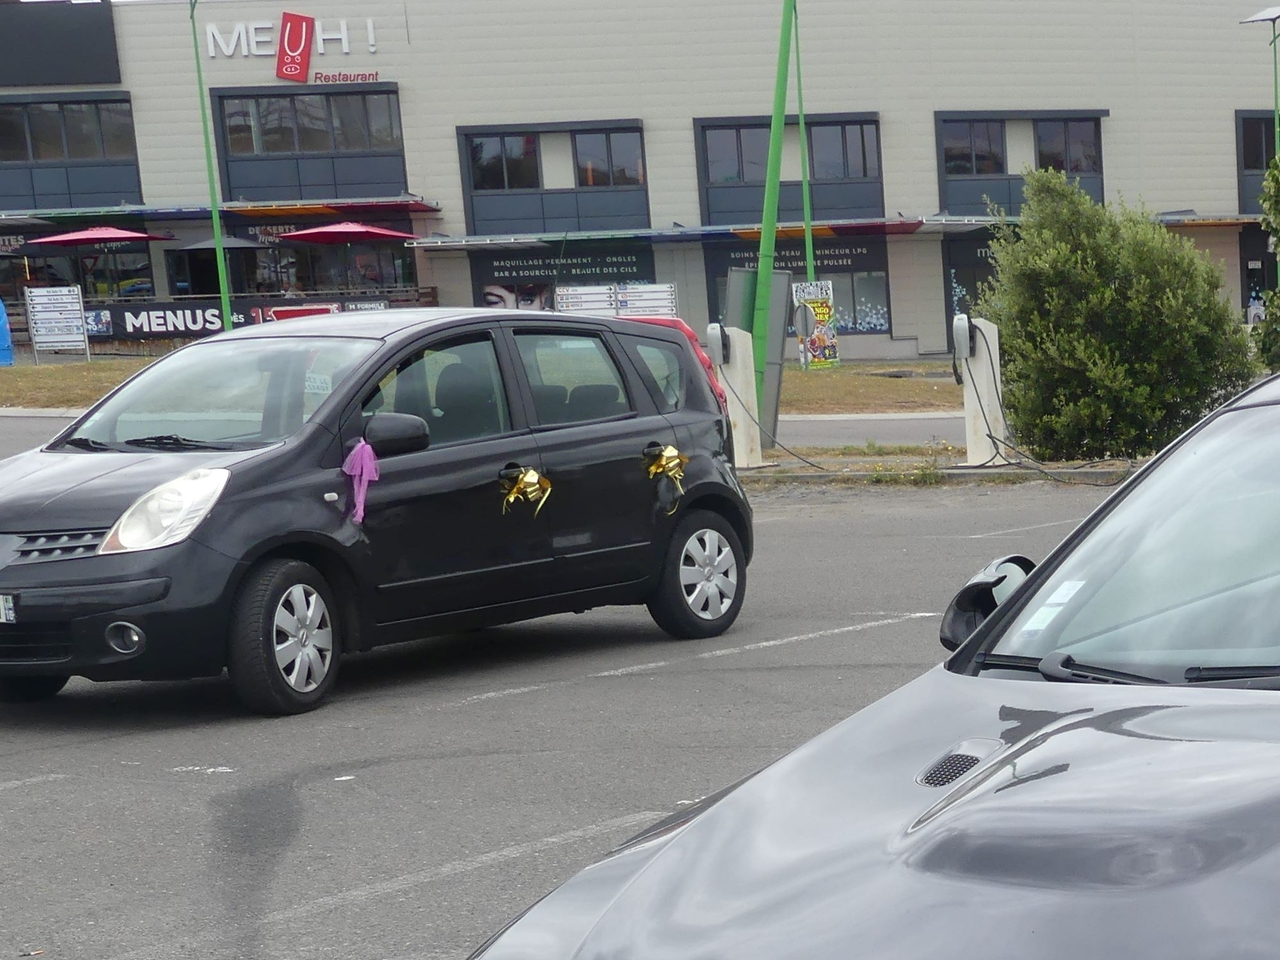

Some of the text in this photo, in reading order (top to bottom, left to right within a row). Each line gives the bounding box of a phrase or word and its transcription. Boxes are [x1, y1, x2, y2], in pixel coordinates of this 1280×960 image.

[206, 18, 378, 58] MEUH !
[314, 71, 379, 83] Restaurant
[781, 250, 801, 258] PEAU
[815, 248, 850, 256] MINCEUR
[493, 255, 637, 268] MAQUILLAGE PERMANENT ONGLES
[788, 259, 821, 268] LUMIRE
[824, 258, 852, 266] PULSÉE
[494, 270, 510, 278] BAR
[519, 269, 558, 277] SOURCILS
[124, 308, 222, 333] MENUS
